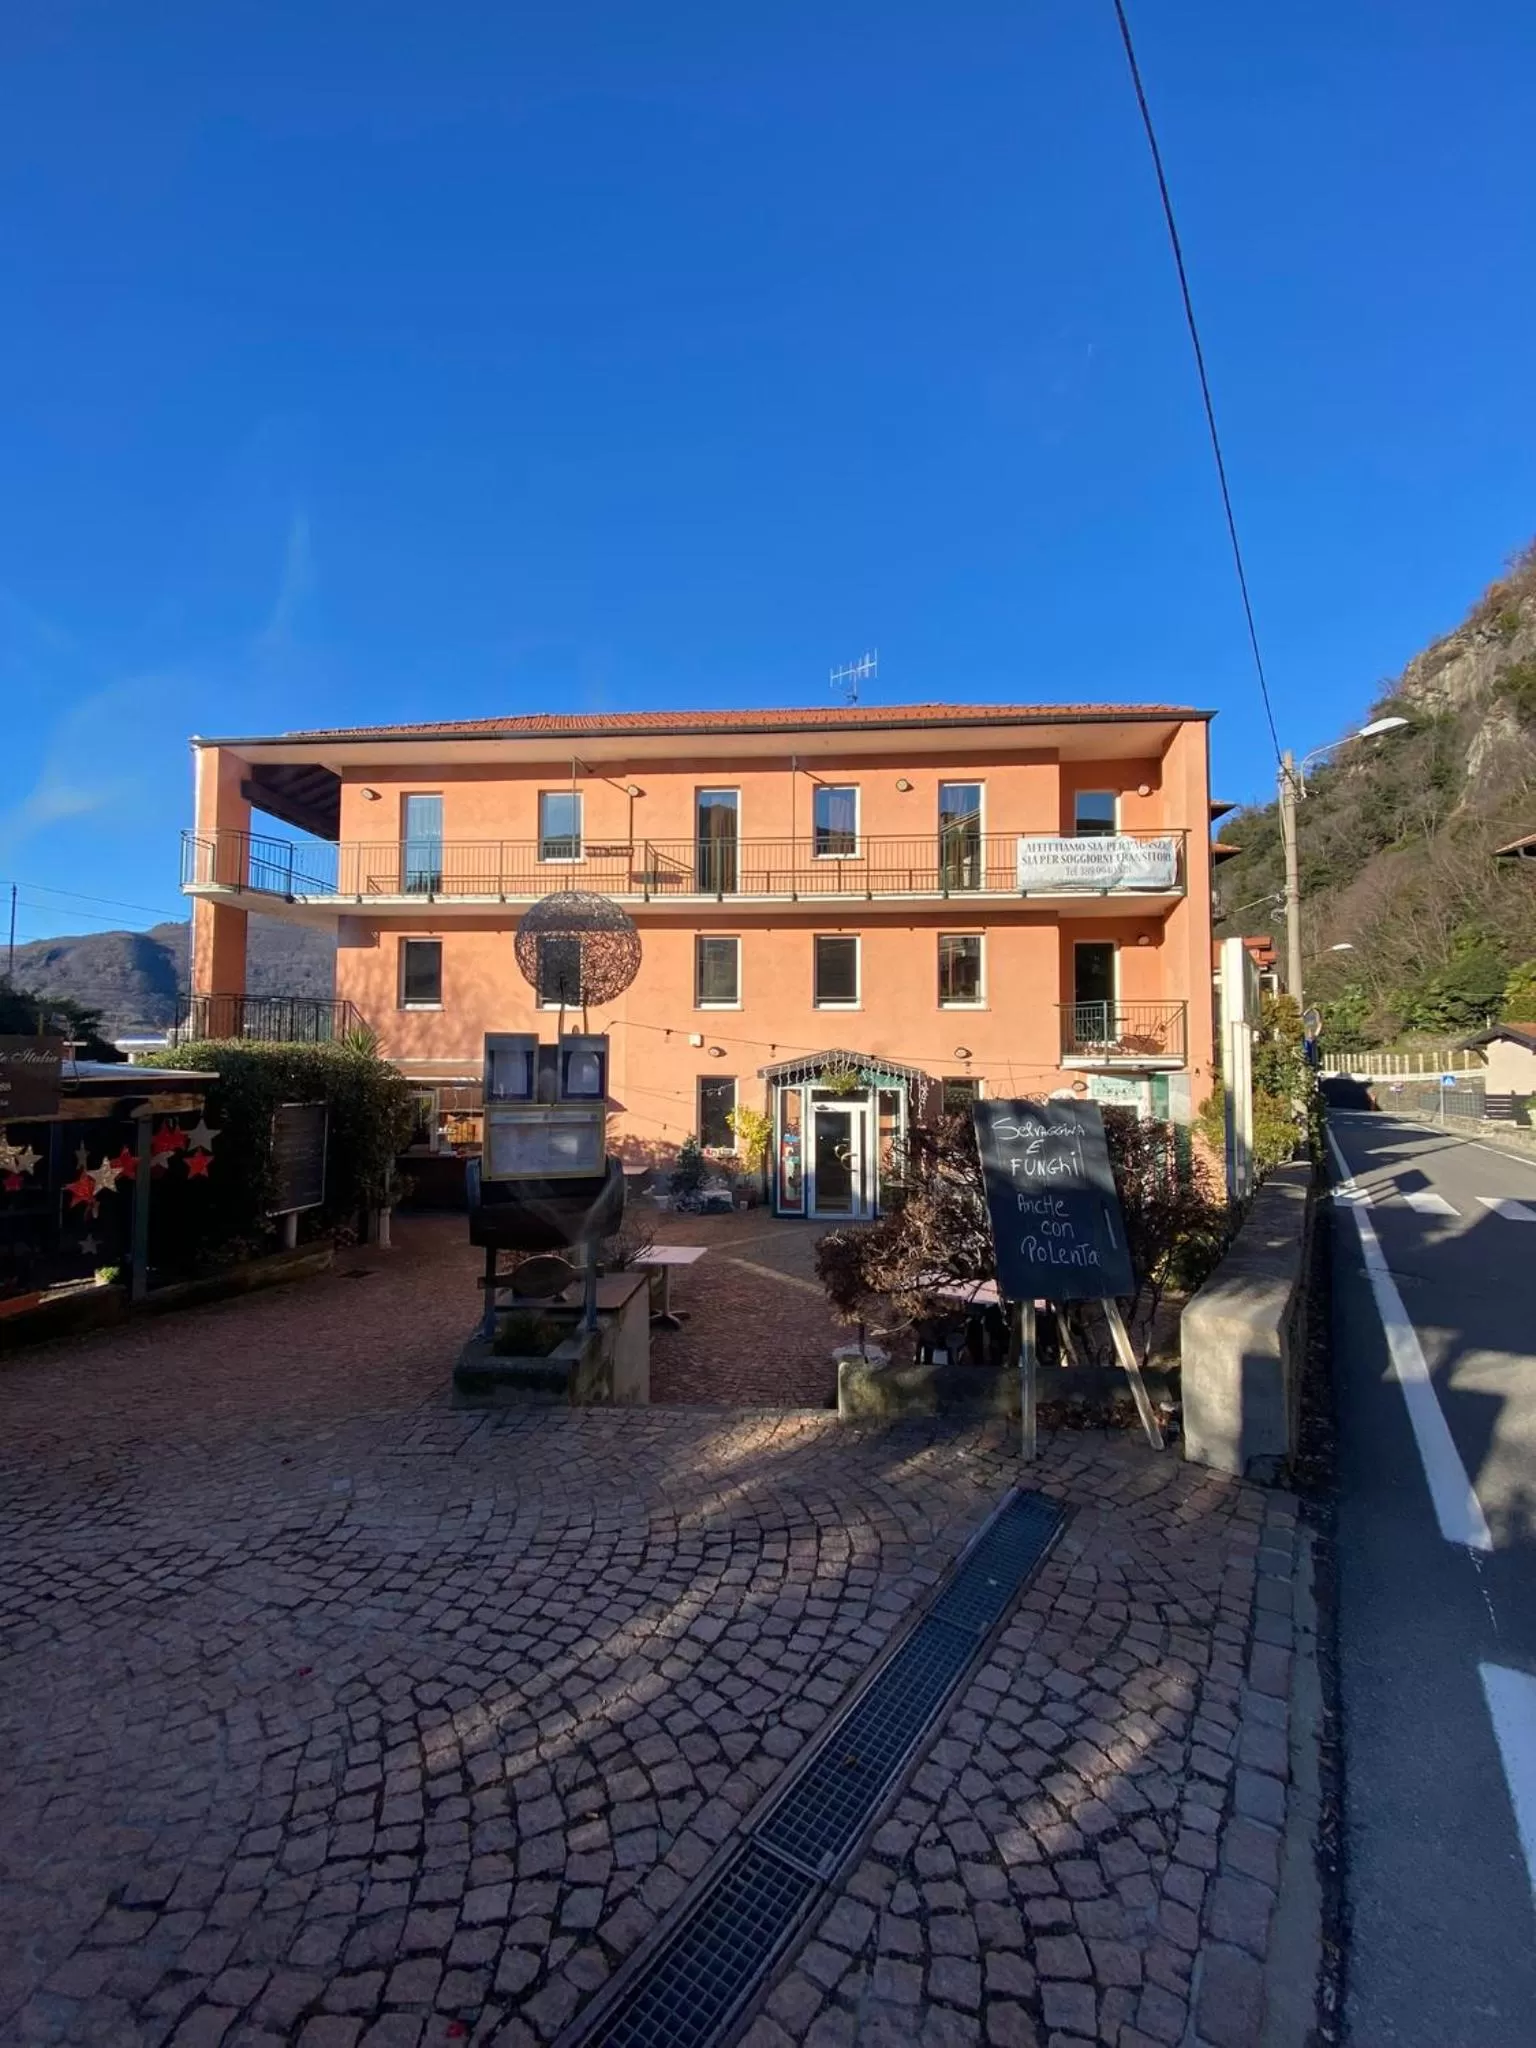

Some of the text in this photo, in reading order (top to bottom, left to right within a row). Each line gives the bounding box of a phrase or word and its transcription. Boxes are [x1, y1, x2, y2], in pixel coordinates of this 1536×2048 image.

[1087, 842, 1103, 852] SIA
[1022, 855, 1038, 865] SIA
[1040, 854, 1059, 864] PER
